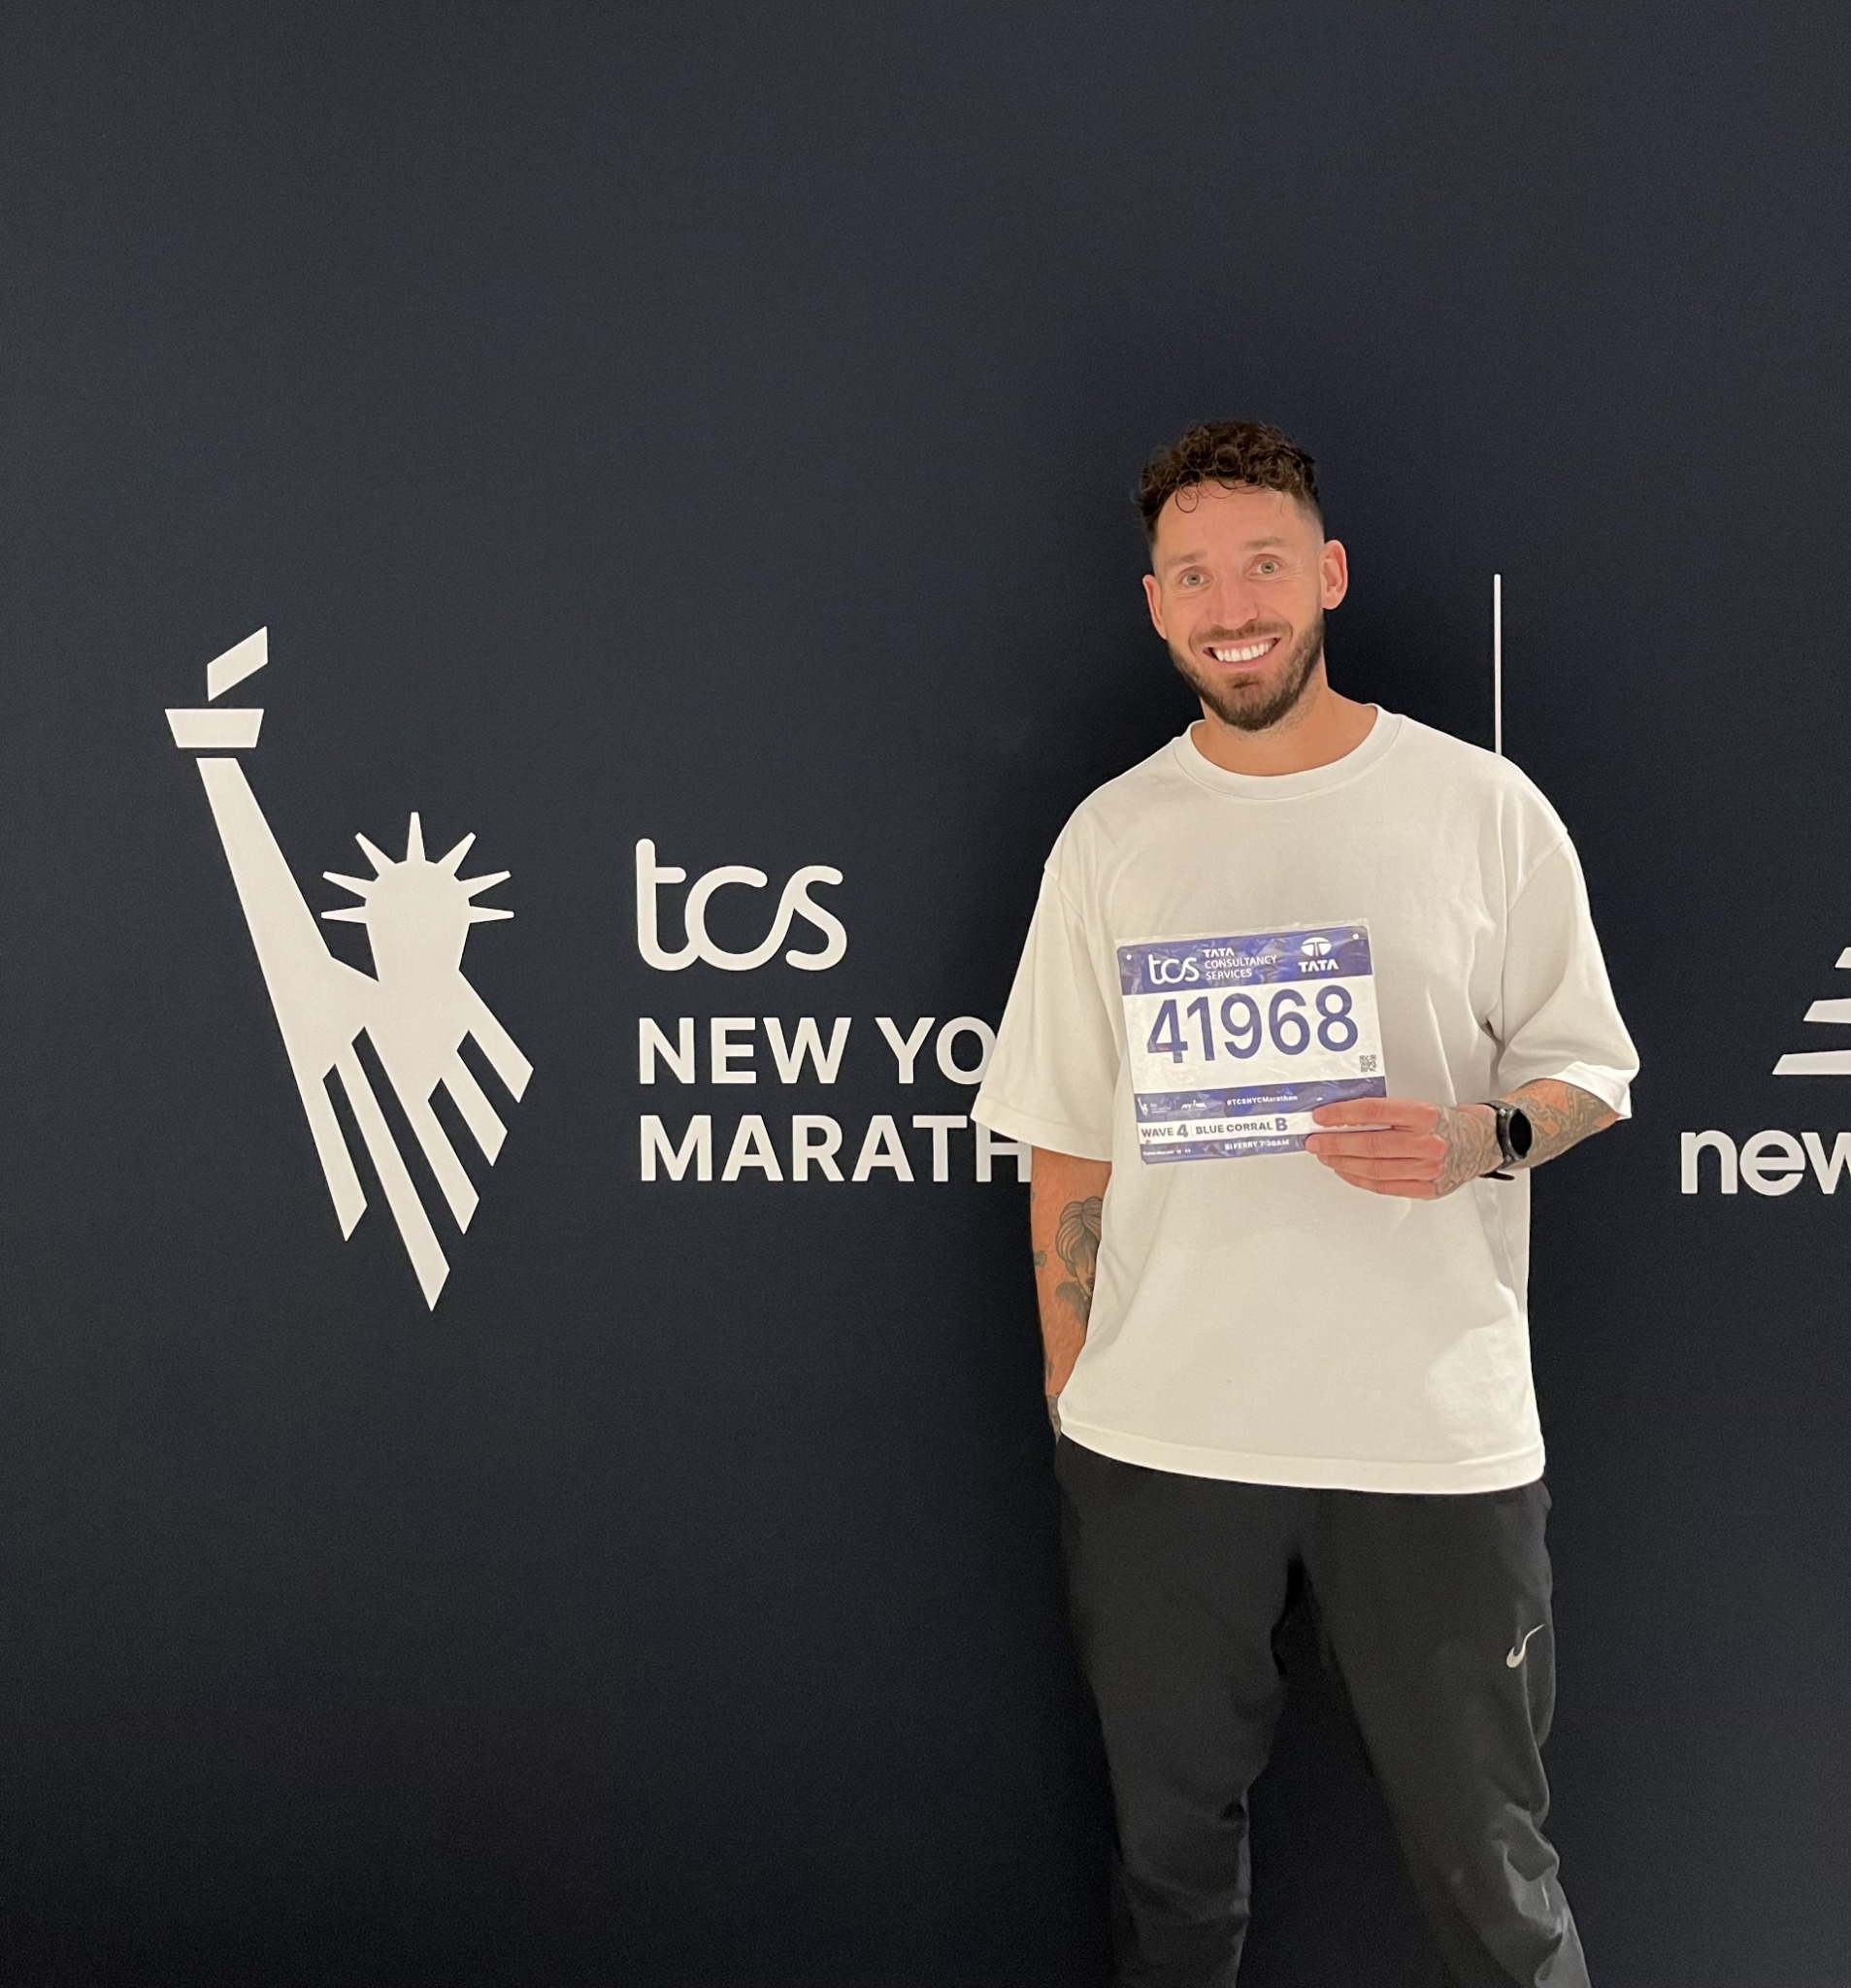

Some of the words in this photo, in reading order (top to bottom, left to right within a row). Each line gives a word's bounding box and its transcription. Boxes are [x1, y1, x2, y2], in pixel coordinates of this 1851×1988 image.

[636, 839, 847, 971] tcs
[1203, 947, 1235, 958] TATA
[1205, 954, 1277, 969] CONSULTANCY
[1147, 953, 1200, 985] tcs
[1206, 968, 1253, 980] SERVICES
[1298, 958, 1339, 973] TATA
[1147, 984, 1359, 1064] 41968
[639, 1016, 852, 1085] NEW
[1140, 1127, 1173, 1138] WAVE
[1176, 1123, 1189, 1138] 4
[1195, 1124, 1225, 1135] BLUE
[1226, 1121, 1273, 1133] CORRAL
[1274, 1117, 1288, 1132] B
[1233, 1141, 1258, 1150] FERRY
